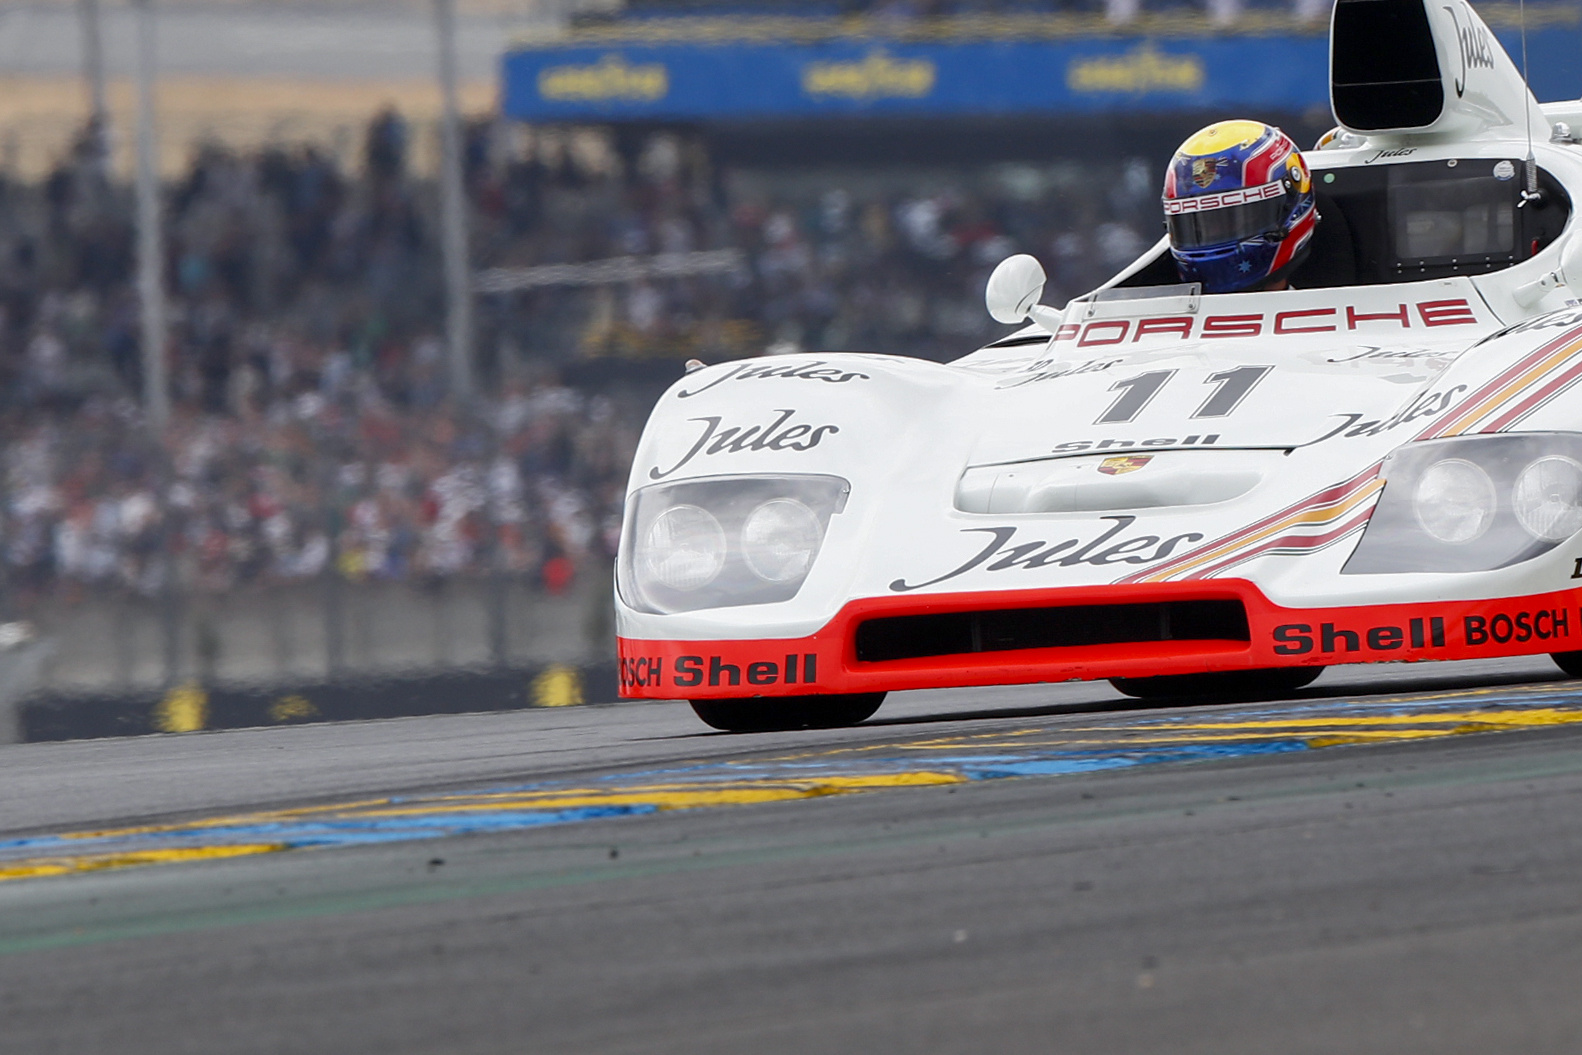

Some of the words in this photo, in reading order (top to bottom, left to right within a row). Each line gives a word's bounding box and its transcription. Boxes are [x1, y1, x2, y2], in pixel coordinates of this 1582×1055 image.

[1443, 0, 1494, 99] Jules
[1365, 146, 1418, 163] Jules
[1164, 183, 1281, 213] PORSCHE
[1055, 299, 1478, 348] PORSCHE
[677, 361, 870, 398] Jules
[1092, 365, 1276, 425] 11
[1296, 384, 1468, 447] Jules
[649, 409, 840, 480] Jules
[1052, 434, 1221, 453] Shell
[889, 515, 1204, 592] Jules
[1273, 616, 1447, 656] Shell
[1464, 608, 1569, 646] BOSCH
[619, 657, 662, 687] OSCH
[673, 653, 817, 687] Shell
